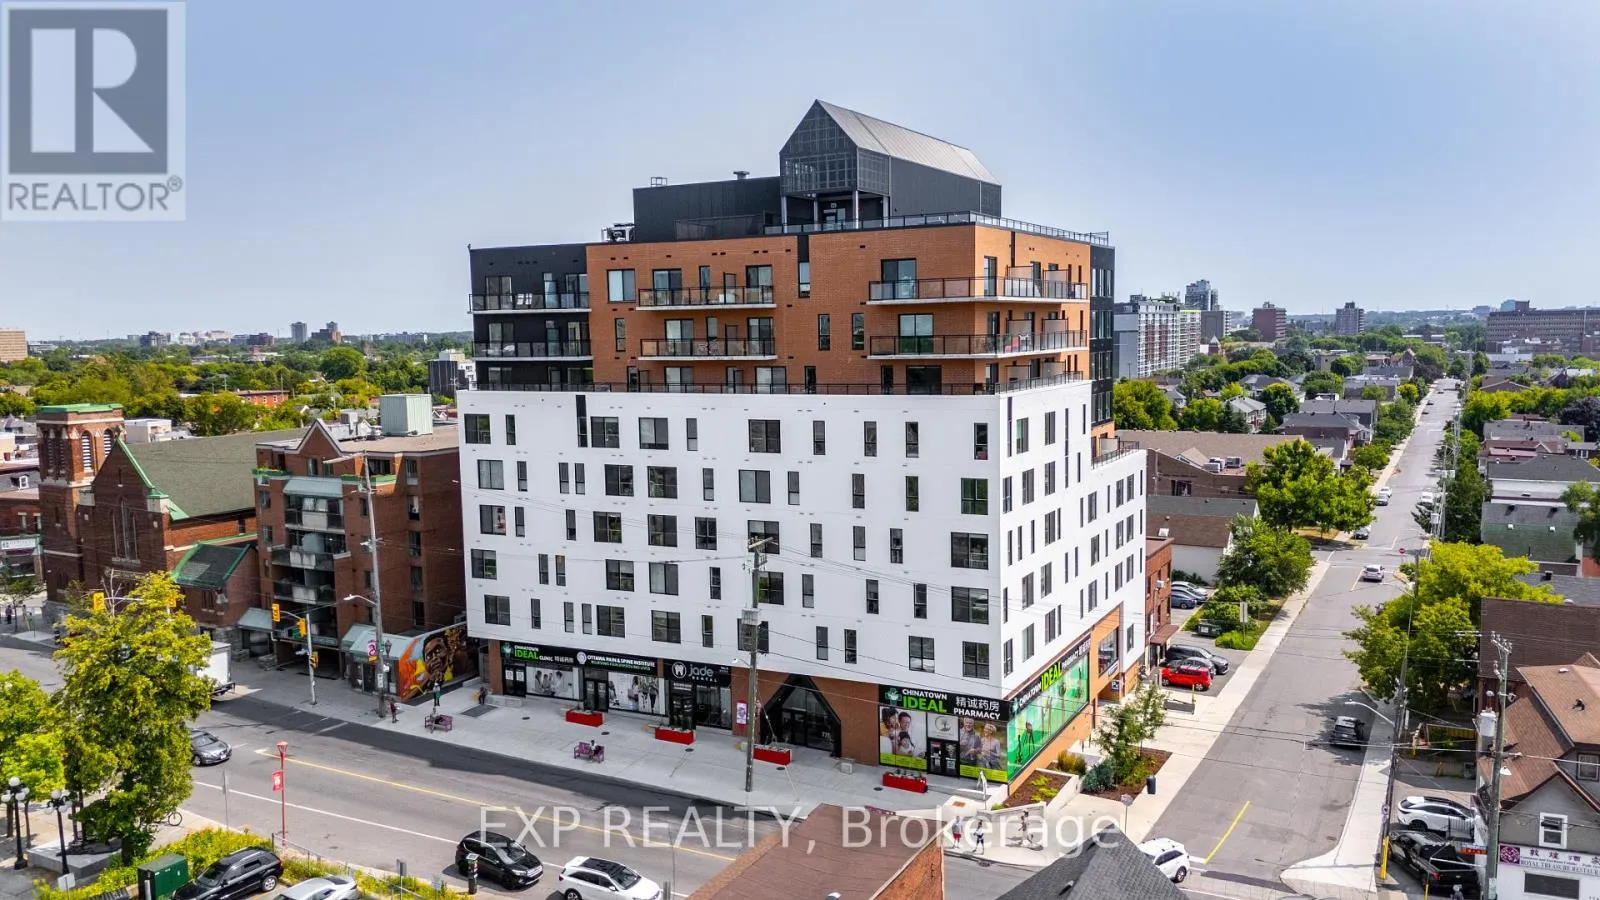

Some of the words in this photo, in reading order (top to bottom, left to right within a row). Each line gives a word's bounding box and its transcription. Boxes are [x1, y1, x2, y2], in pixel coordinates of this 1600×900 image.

[514, 649, 539, 660] IDEAL
[688, 664, 714, 677] jade
[1041, 660, 1063, 692] IDEAL
[902, 688, 948, 700] CHINATOWN
[903, 697, 948, 713] IDEAL
[955, 695, 1000, 712] 精诚药房
[953, 707, 1001, 720] PHARMACY
[1521, 859, 1539, 867] ROYAL
